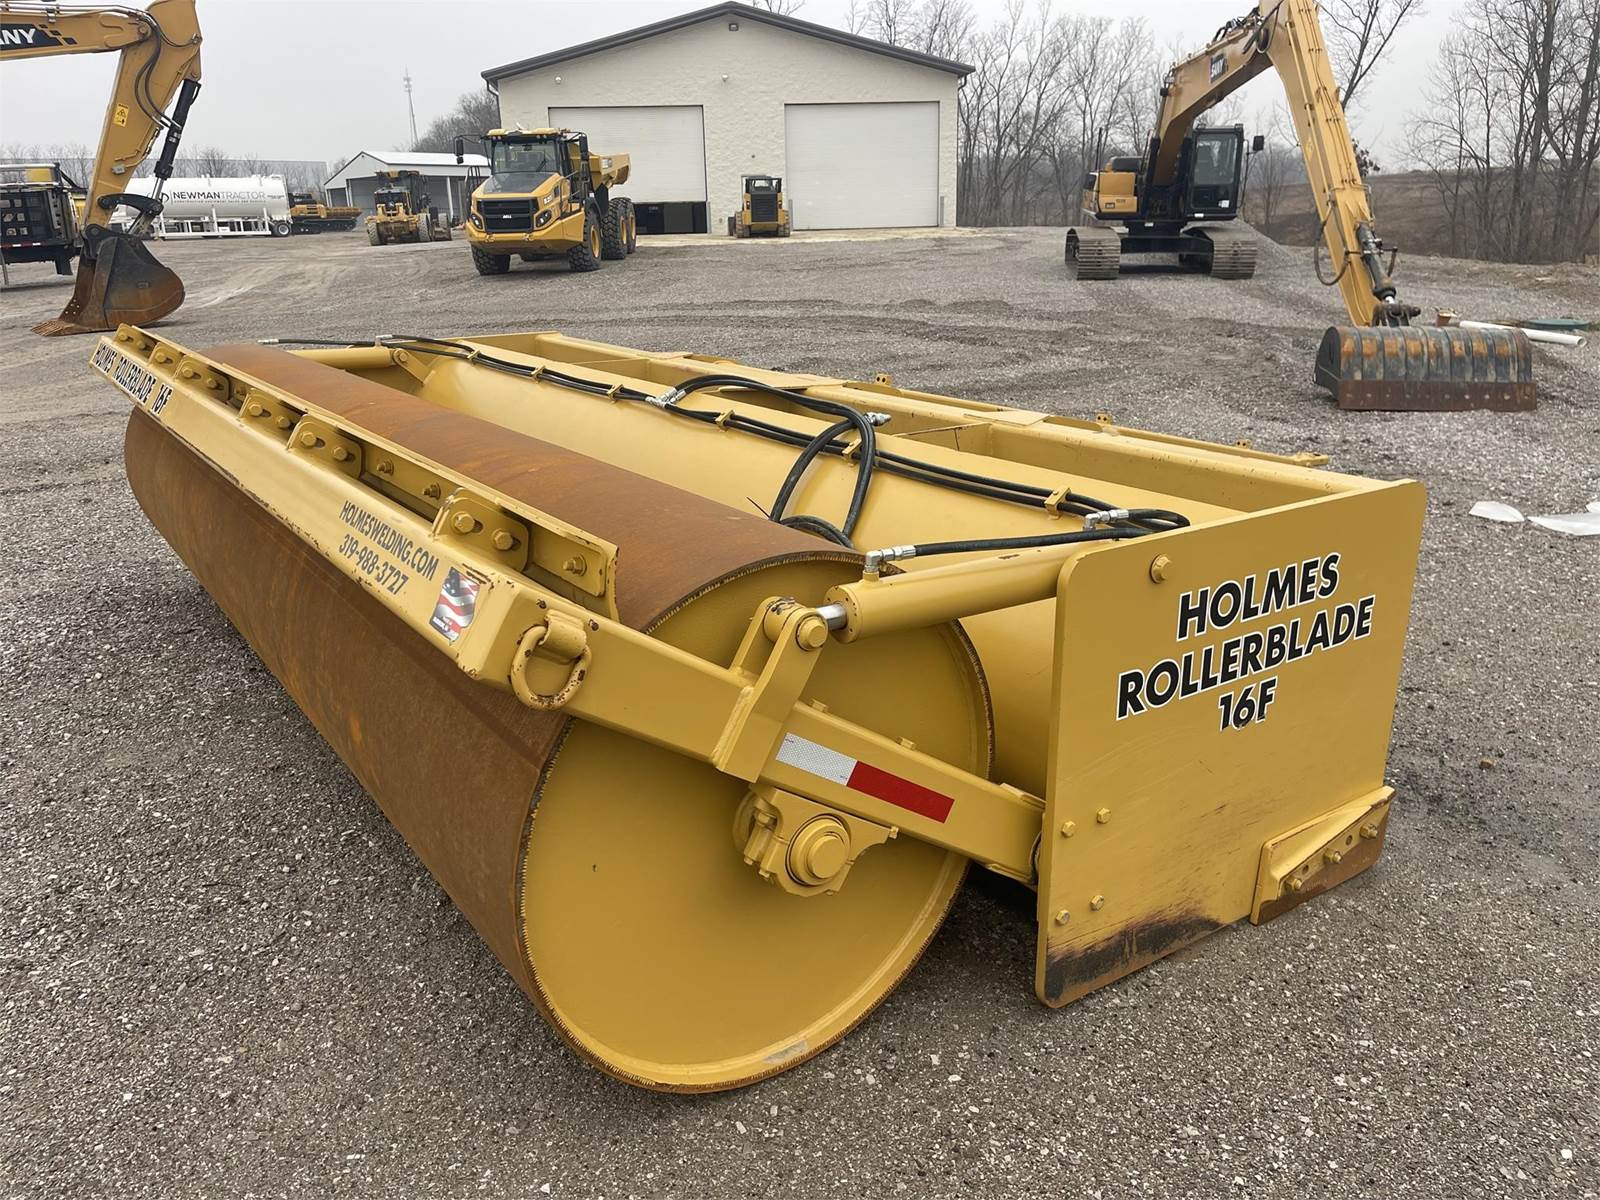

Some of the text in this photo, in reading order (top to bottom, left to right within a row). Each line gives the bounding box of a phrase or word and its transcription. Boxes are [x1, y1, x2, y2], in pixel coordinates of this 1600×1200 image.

[92, 342, 173, 415] HOLMES ROLLERBLADE 16F
[338, 533, 409, 595] 319-988-3727
[339, 500, 440, 581] HOLMESWELDING.COM
[1177, 552, 1341, 642] HOLMES
[1116, 595, 1376, 721] ROLLERBLADE
[1218, 676, 1278, 731] 16F
